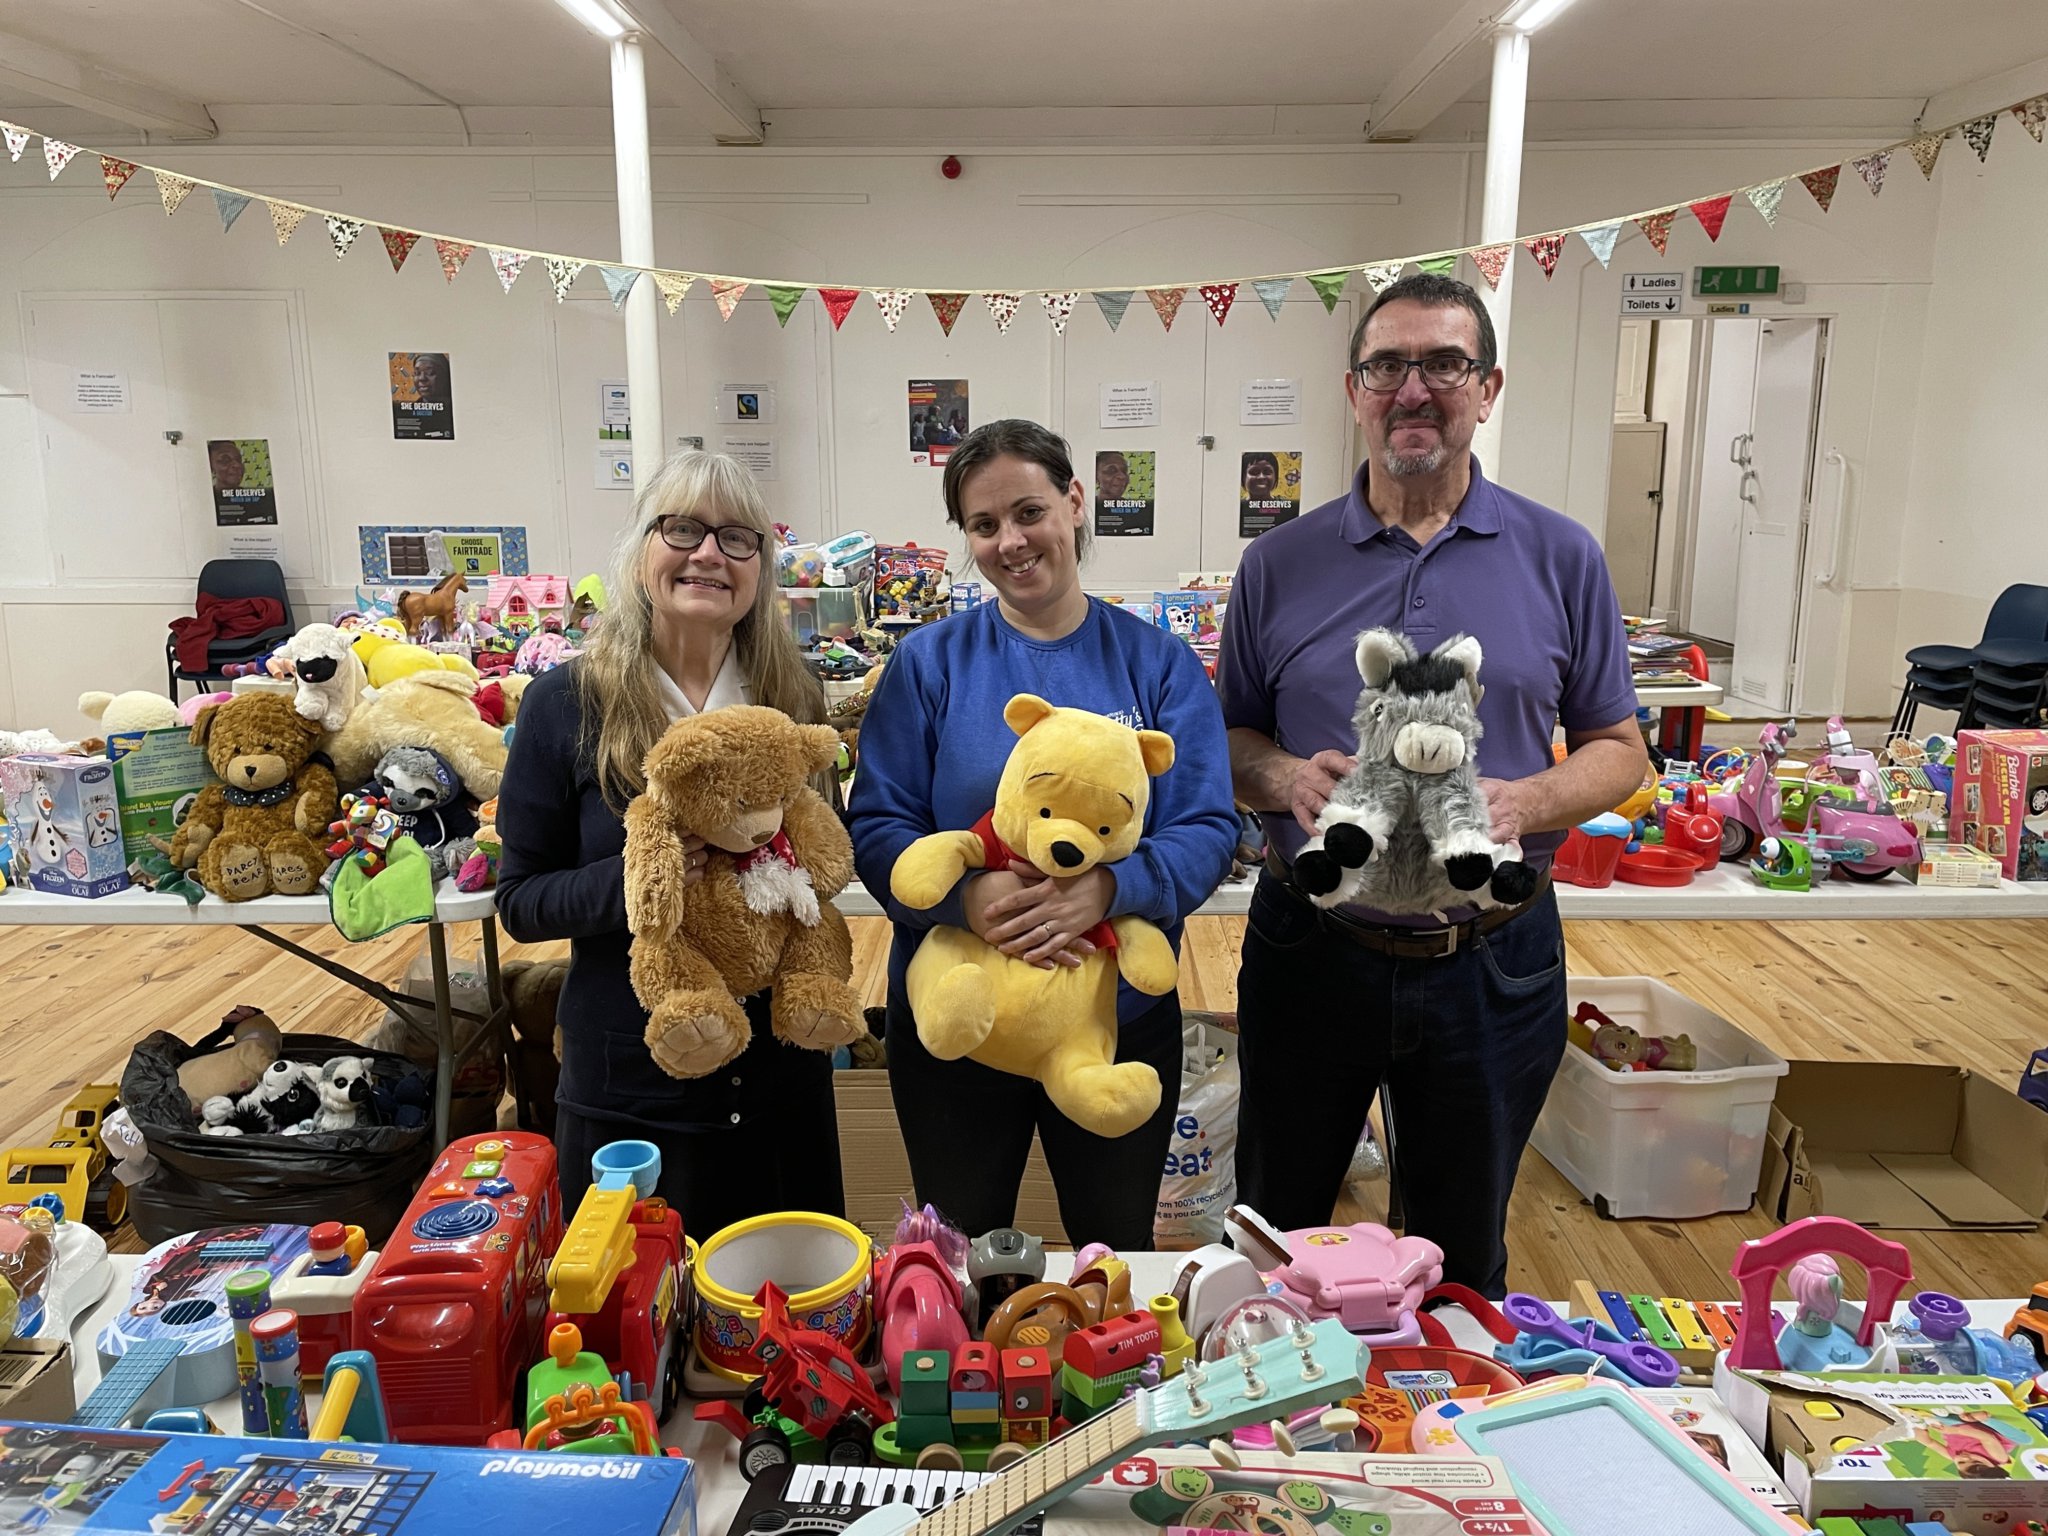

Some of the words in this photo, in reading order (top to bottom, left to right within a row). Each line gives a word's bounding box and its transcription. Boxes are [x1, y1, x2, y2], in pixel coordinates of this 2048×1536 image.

[1642, 278, 1677, 288] Ladies
[1627, 300, 1660, 310] Toilets
[1711, 305, 1735, 313] Ladies
[401, 402, 413, 410] SHE
[414, 402, 444, 411] DESERVES
[222, 489, 234, 497] SHE
[235, 488, 266, 497] DESERVES
[1103, 500, 1116, 508] SHE
[1116, 500, 1146, 508] DESERVES
[1249, 500, 1261, 509] SHE
[1262, 500, 1292, 509] DESERVES
[461, 538, 483, 546] CHOOSE
[453, 546, 493, 556] FAIRTRADE
[1214, 575, 1234, 584] Far
[2000, 754, 2009, 796] PICNIC
[2007, 755, 2020, 800] Barbie
[2003, 799, 2011, 825] VAN
[398, 814, 418, 828] EEP
[42, 873, 65, 883] FROZEN
[71, 887, 89, 897] OLAF
[98, 882, 121, 894] OLAF
[1163, 1145, 1212, 1177] eat.
[1174, 1198, 1196, 1208] 100%
[1174, 1211, 1189, 1219] you
[808, 1291, 858, 1329] BAND
[1118, 1337, 1134, 1351] TIM
[1134, 1329, 1159, 1345] TOOTS
[479, 1457, 643, 1479] playmobil
[829, 1506, 852, 1516] 61
[1493, 1501, 1506, 1512] 8
